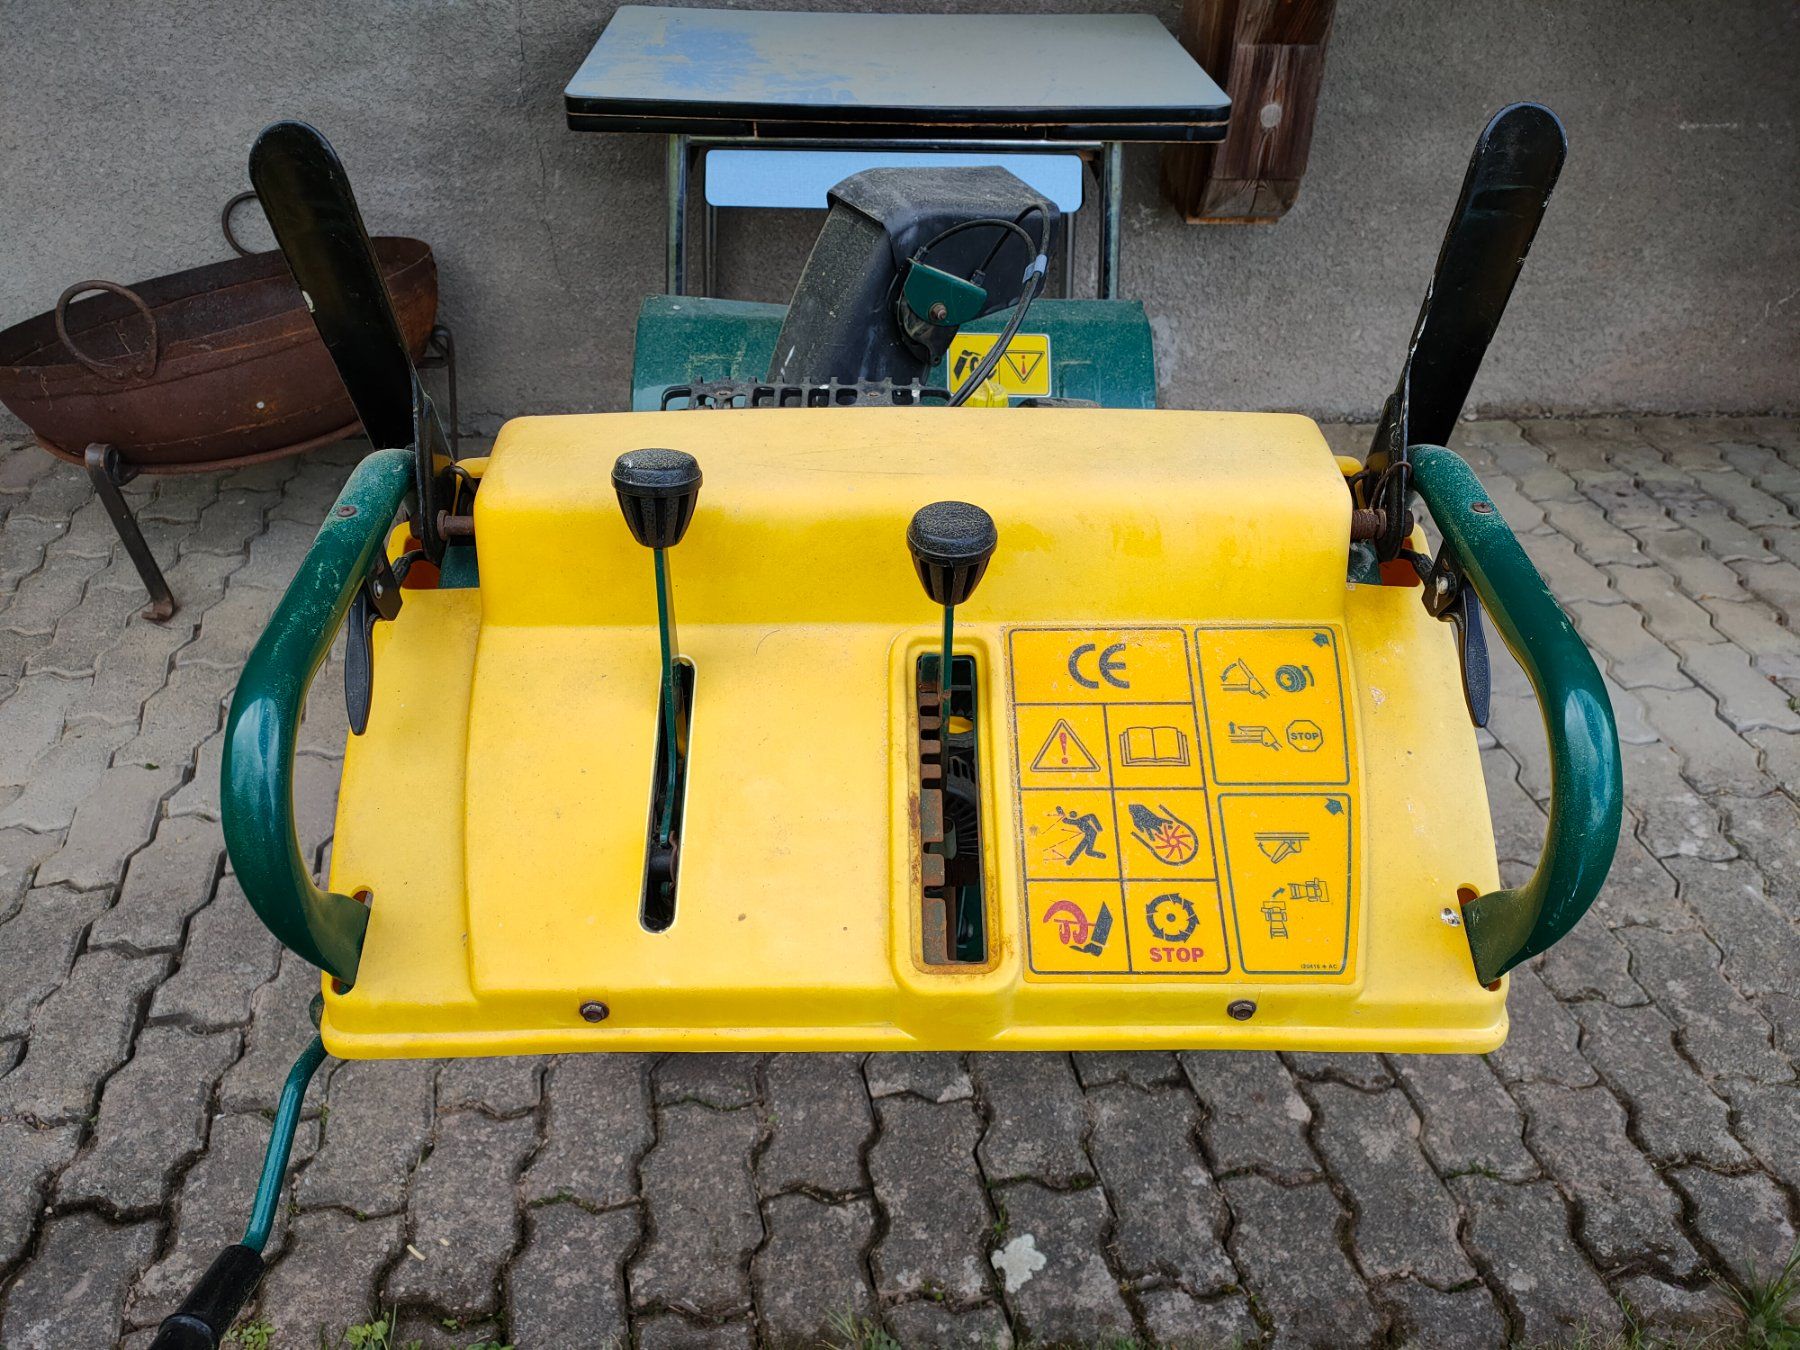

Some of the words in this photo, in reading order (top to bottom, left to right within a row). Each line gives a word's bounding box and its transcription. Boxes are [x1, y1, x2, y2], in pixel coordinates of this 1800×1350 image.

[1068, 643, 1130, 689] CE
[1290, 732, 1319, 740] STOP
[1149, 947, 1204, 963] STOP
